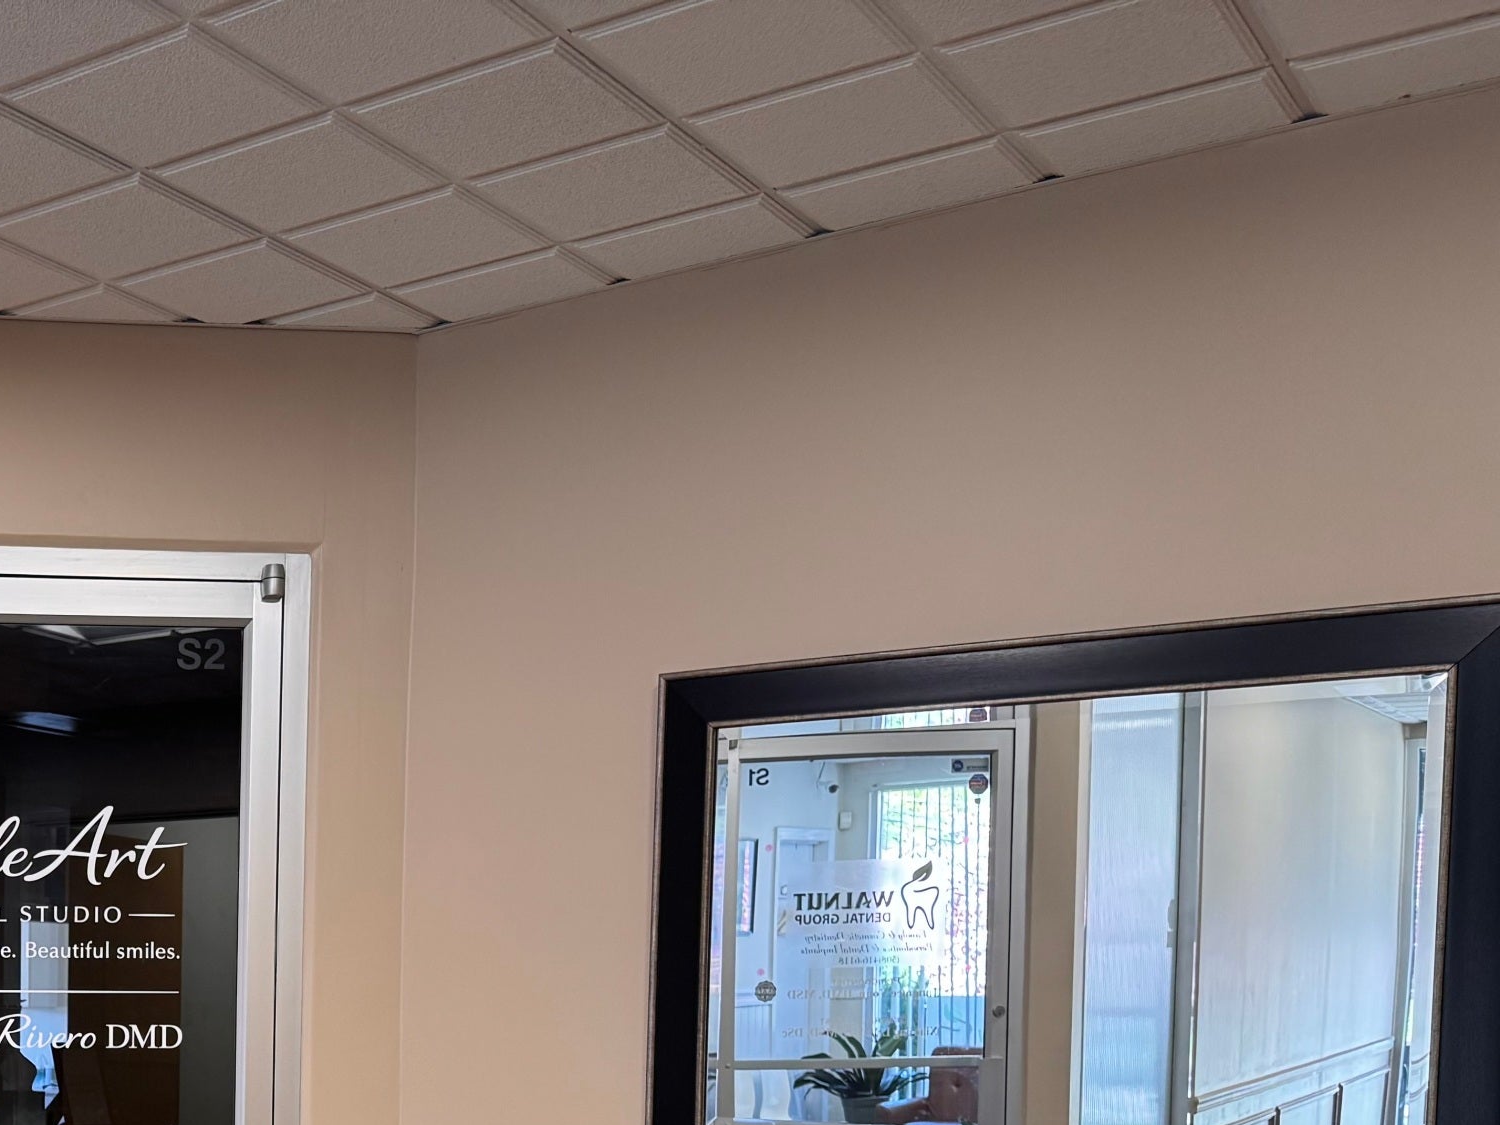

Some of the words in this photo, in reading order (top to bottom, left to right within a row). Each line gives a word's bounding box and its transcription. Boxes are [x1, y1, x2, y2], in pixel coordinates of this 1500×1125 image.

[176, 637, 225, 671] S2
[19, 904, 123, 924] STUDIO
[25, 940, 110, 961] Beautiful
[116, 941, 182, 961] smiles.
[105, 1023, 184, 1050] DMD
